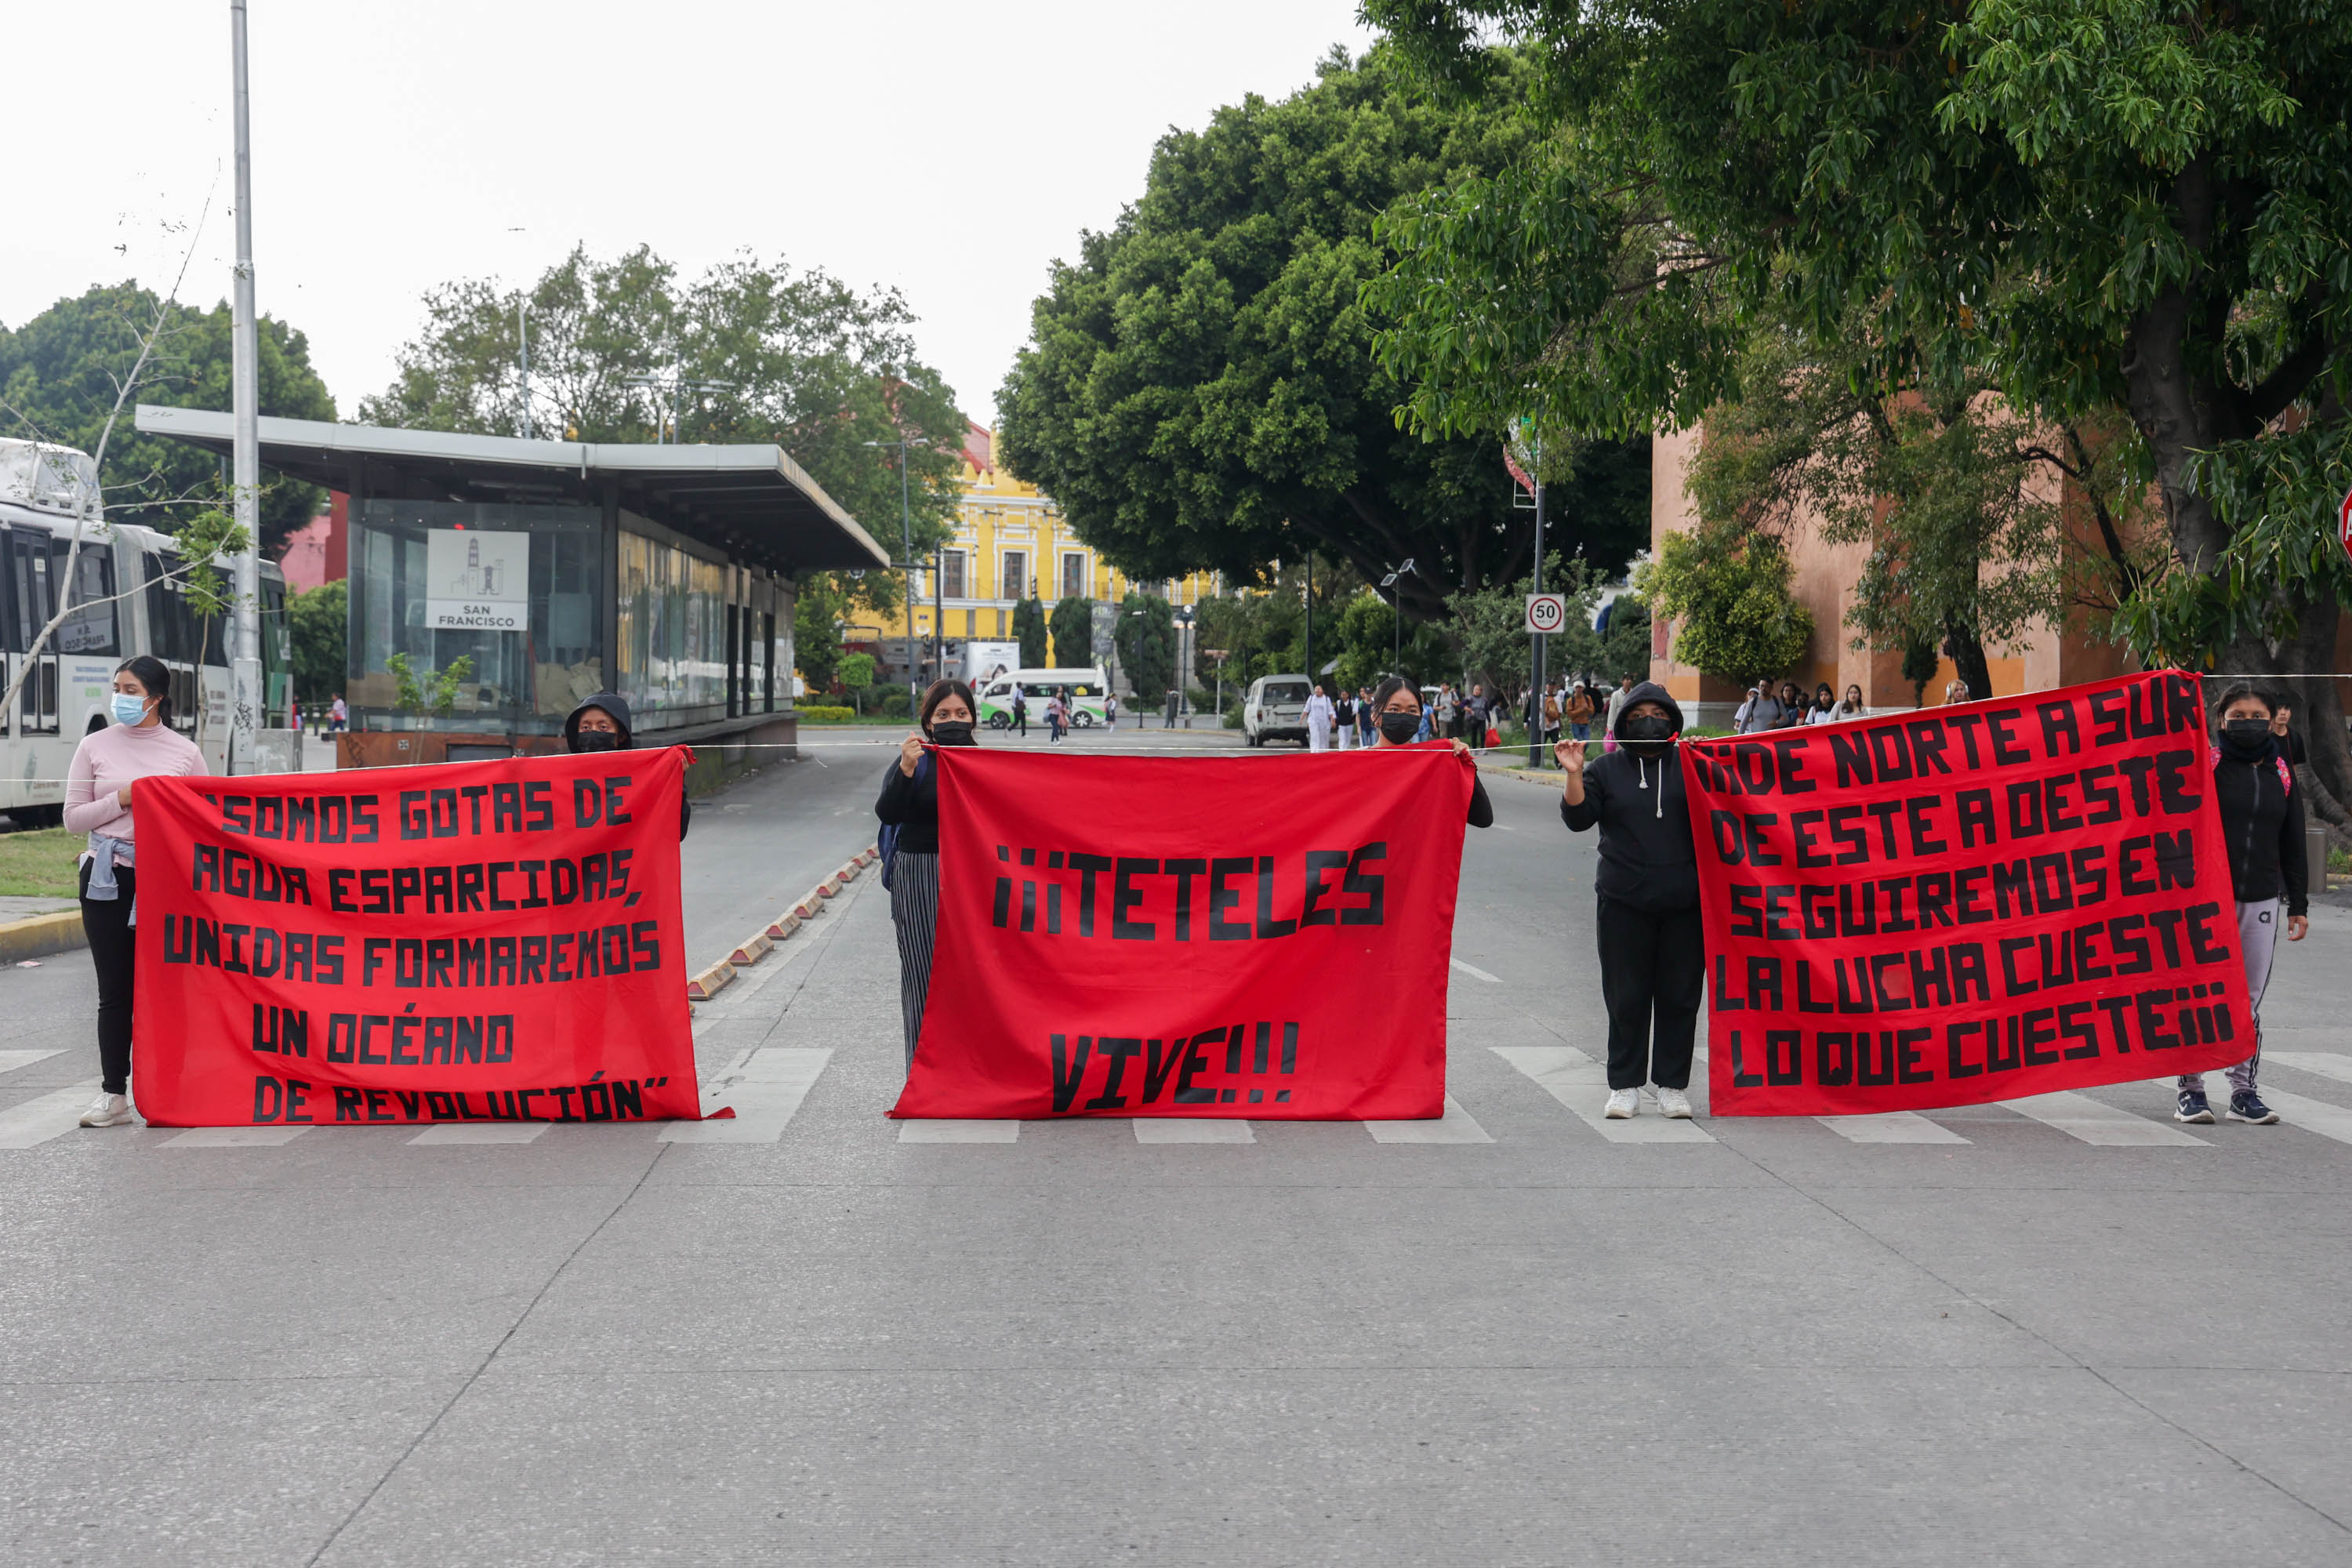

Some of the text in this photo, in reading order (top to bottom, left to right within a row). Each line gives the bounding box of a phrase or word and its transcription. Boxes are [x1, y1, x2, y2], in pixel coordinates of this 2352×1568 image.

[438, 615, 515, 627] FRANCISCO
[463, 604, 491, 615] SAN
[1536, 604, 1555, 619] 50
[1828, 709, 2031, 789] NORTE
[2036, 700, 2081, 758] A
[2086, 674, 2200, 748] SUR
[400, 780, 554, 840] GOTAS
[573, 775, 632, 829] DE
[1710, 750, 2202, 869] DE ESTE A OESTE
[193, 841, 643, 914] AGUA ESPARCIDAS,
[1730, 828, 2196, 940] SEGUIREMOS EN
[164, 913, 661, 988] UNIDAS FORMAREMOS
[1715, 901, 2231, 1014] LA LUCHA CUESTE
[252, 1002, 514, 1065] UN OCÉANO
[1050, 1022, 1300, 1113] VIVE!!!
[1731, 1029, 1802, 1088] LO
[1817, 1026, 1934, 1087] QUE
[252, 1076, 314, 1123] DE
